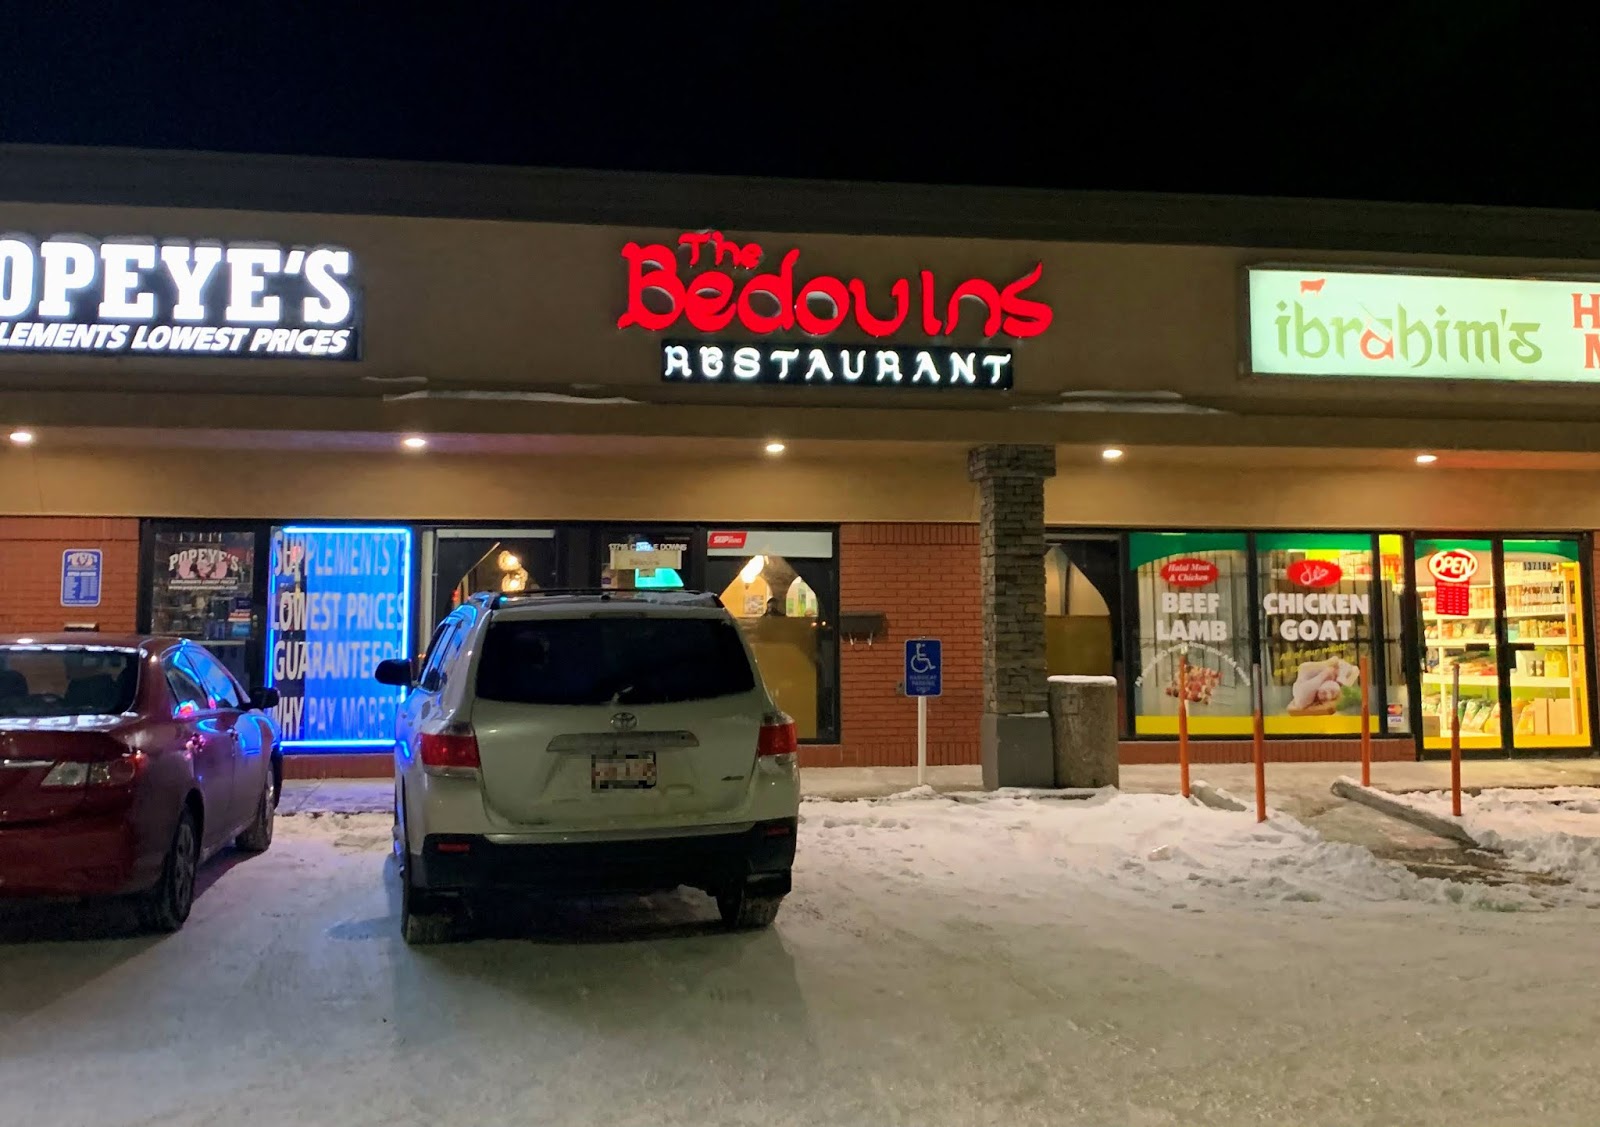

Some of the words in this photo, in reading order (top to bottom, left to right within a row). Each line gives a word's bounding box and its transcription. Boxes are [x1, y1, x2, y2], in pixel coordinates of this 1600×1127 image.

[678, 231, 763, 269] The
[0, 240, 350, 324] OPEYE'S
[617, 241, 1053, 338] Bedouins
[131, 325, 250, 351] LOWEST
[249, 327, 350, 354] PRICES
[664, 345, 1012, 384] RESTAURANT
[660, 543, 687, 551] DOWNS
[168, 548, 239, 571] POPEYE'S
[1168, 563, 1190, 571] Halal
[1191, 563, 1210, 571] Meat
[1434, 555, 1474, 575] OPEN
[1177, 573, 1209, 581] Chicken
[270, 591, 342, 632] LOWEST
[346, 592, 405, 631] PRICES
[1162, 592, 1220, 613] BEEF
[1263, 593, 1369, 615] CHICKEN
[1157, 620, 1227, 641] LAMB
[1280, 619, 1351, 641] GOAT
